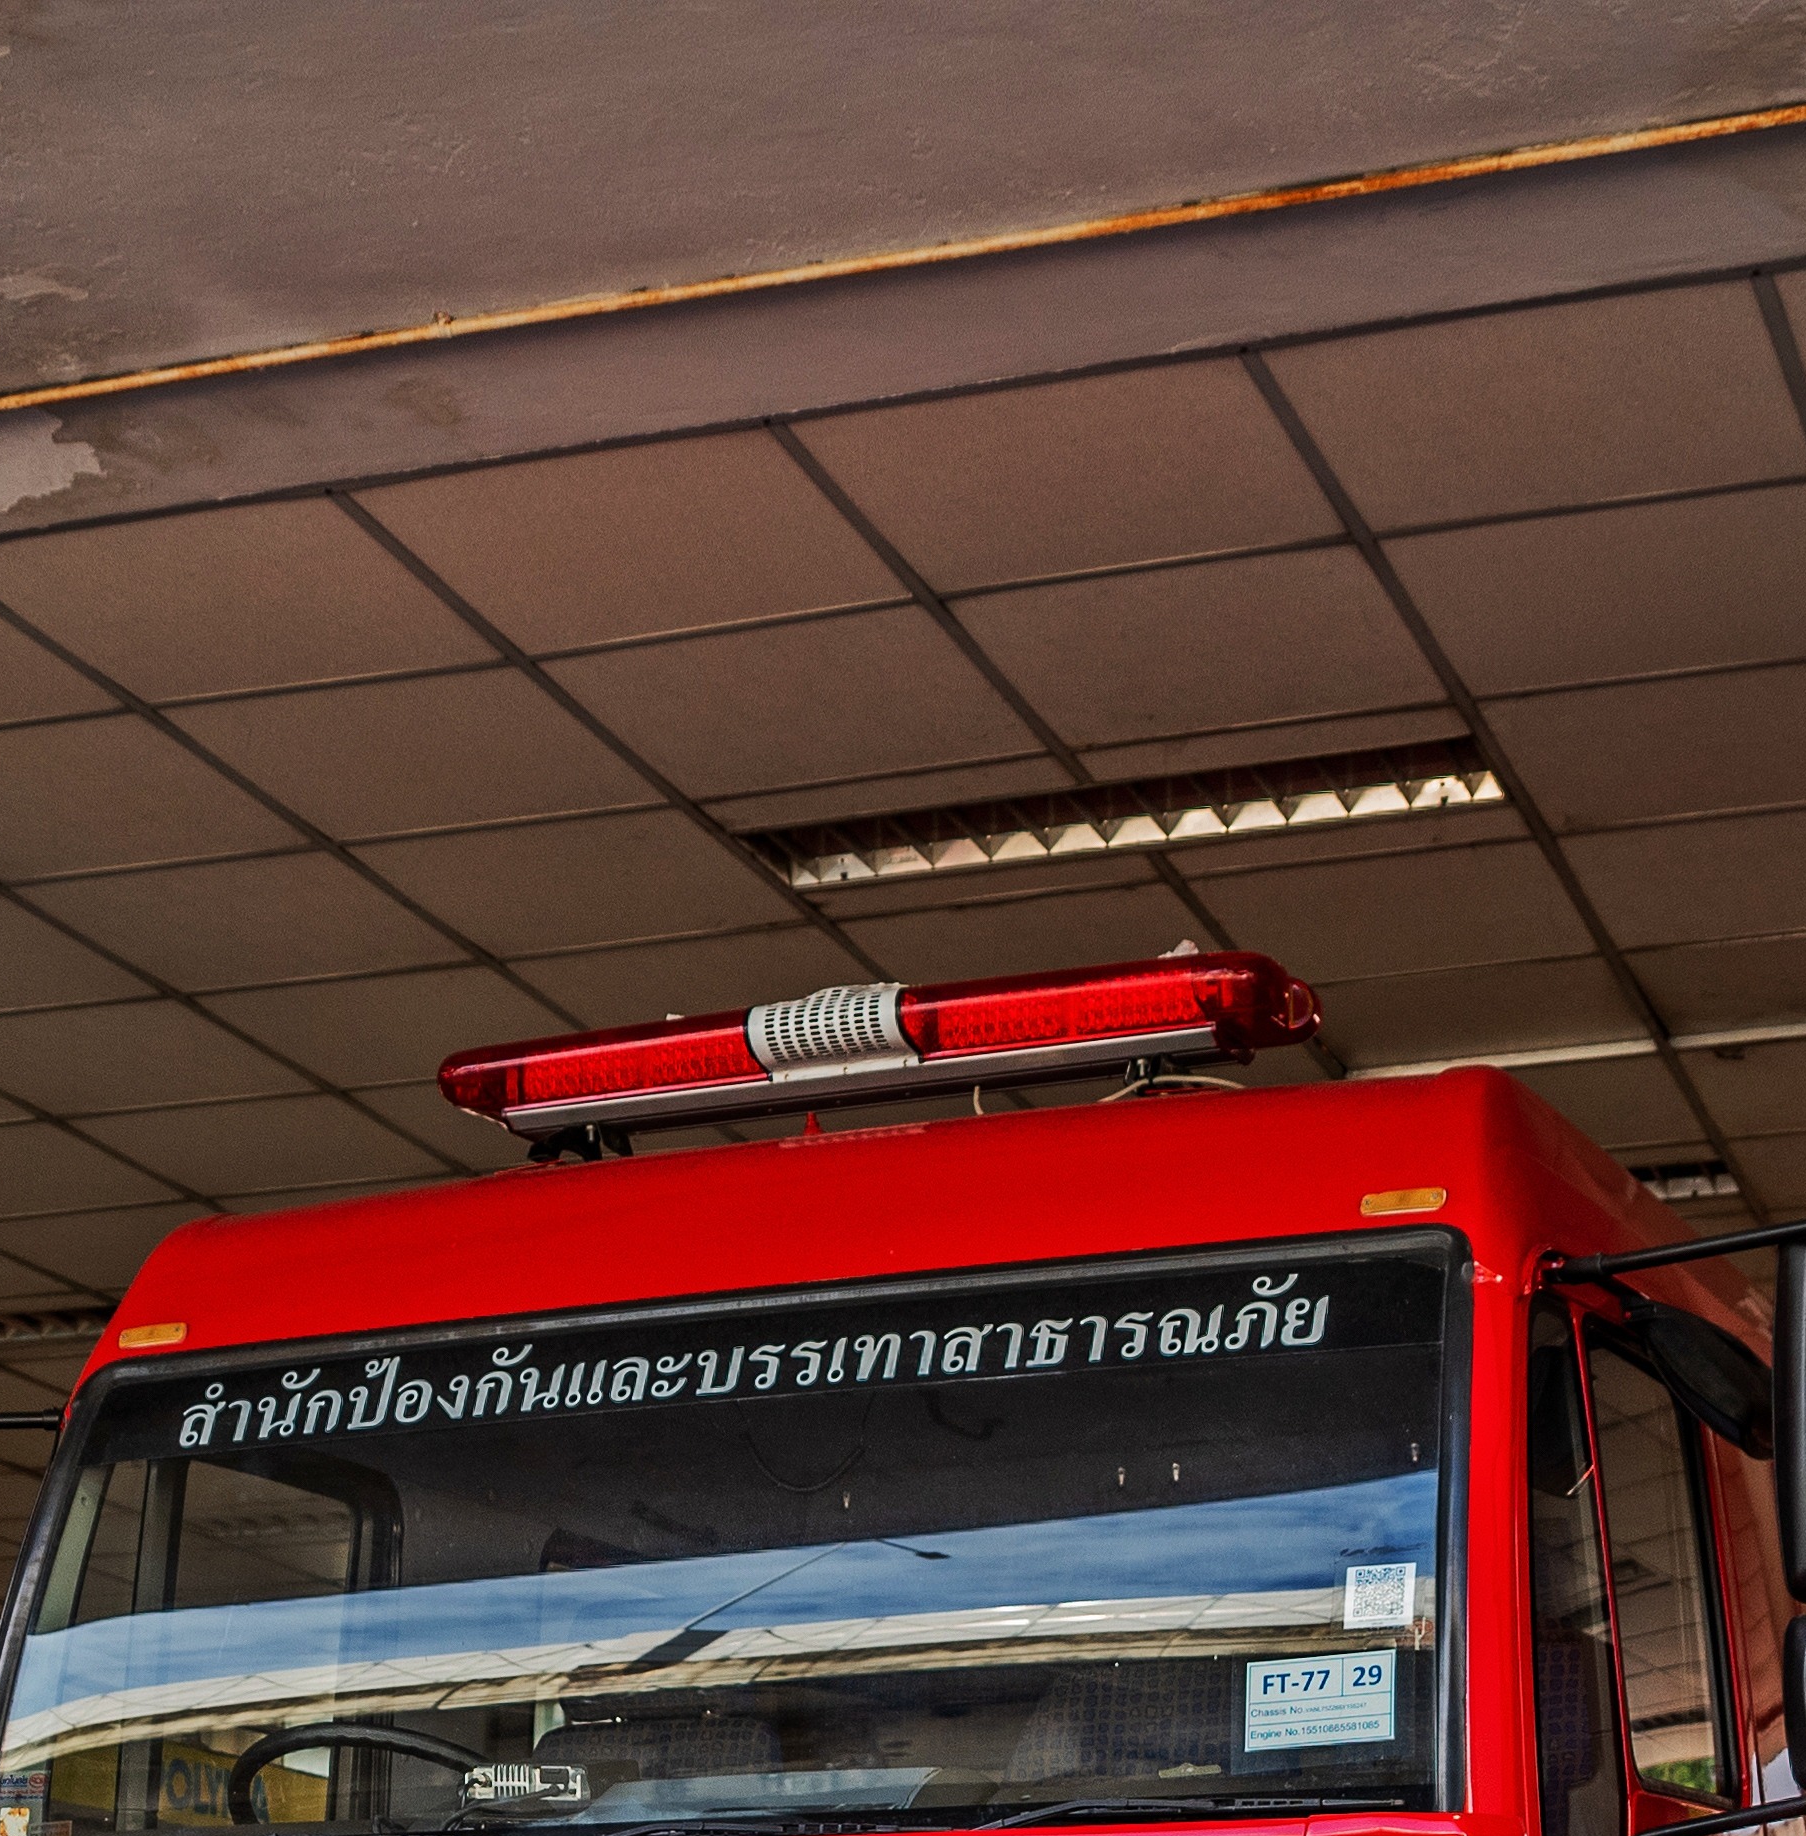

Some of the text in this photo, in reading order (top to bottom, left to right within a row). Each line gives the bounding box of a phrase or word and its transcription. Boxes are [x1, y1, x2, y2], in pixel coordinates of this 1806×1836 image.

[178, 1272, 1331, 1449] สำนักป้องกันและบรรเทาสาธารณภัย
[1262, 1664, 1383, 1695] FT-77 29
[1250, 1705, 1287, 1718] Chassis
[1250, 1729, 1282, 1741] Engine
